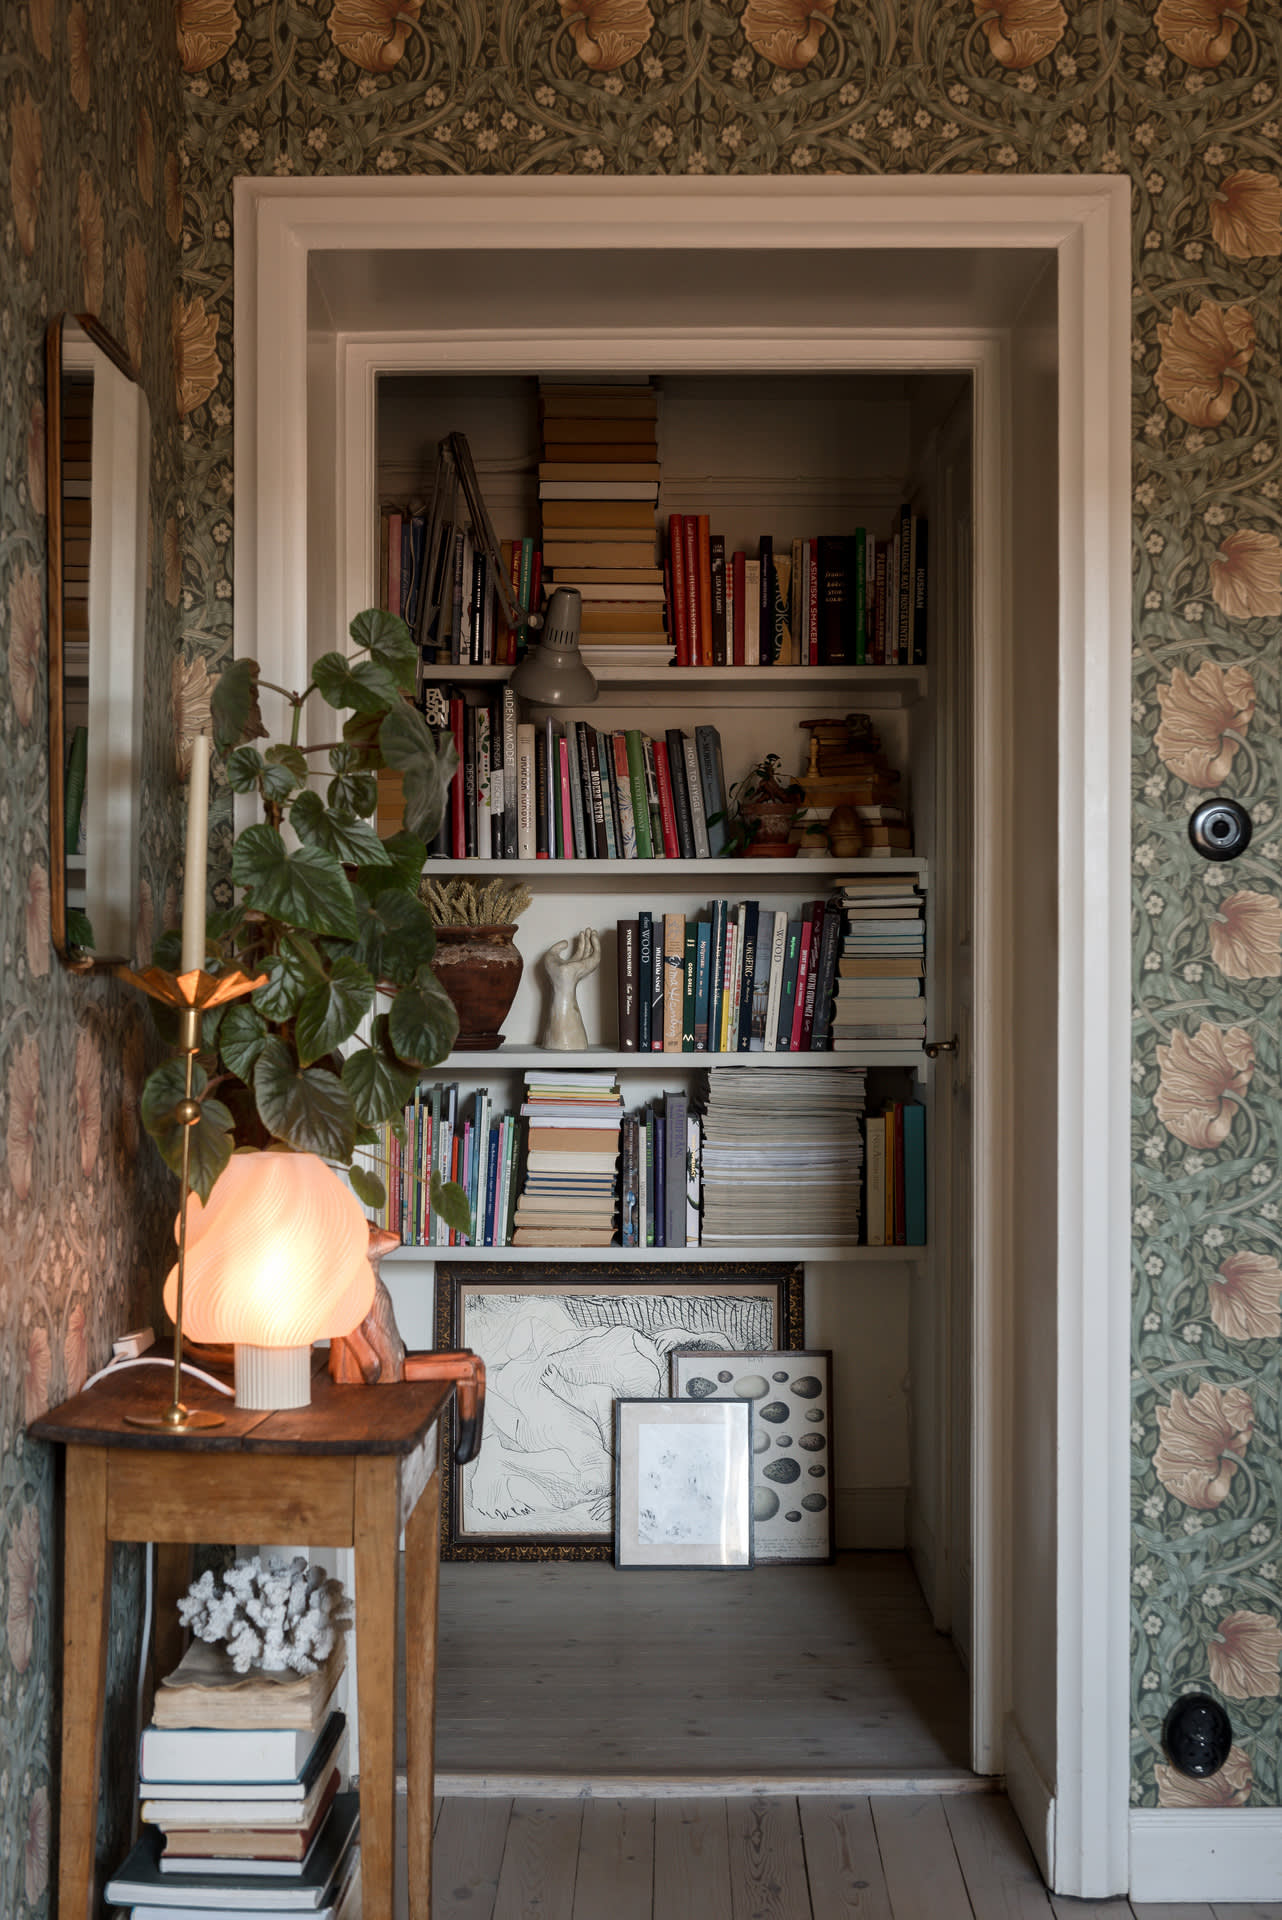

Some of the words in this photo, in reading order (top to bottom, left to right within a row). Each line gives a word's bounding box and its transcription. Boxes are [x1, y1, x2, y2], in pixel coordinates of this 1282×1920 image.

[810, 560, 818, 606] ASIATISKA
[916, 568, 926, 609] HUSMAN
[810, 607, 818, 644] SMAKER
[505, 689, 514, 721] BILDEN
[505, 722, 513, 733] AV
[505, 733, 515, 768] MODET
[687, 747, 696, 768] HOW
[465, 763, 475, 796] DESIGN
[591, 771, 602, 799] MODERN
[690, 770, 698, 782] TO
[593, 801, 604, 823] RETRO
[691, 784, 701, 813] HYGGE
[641, 929, 651, 964] WOOD
[774, 928, 785, 963] WOOD
